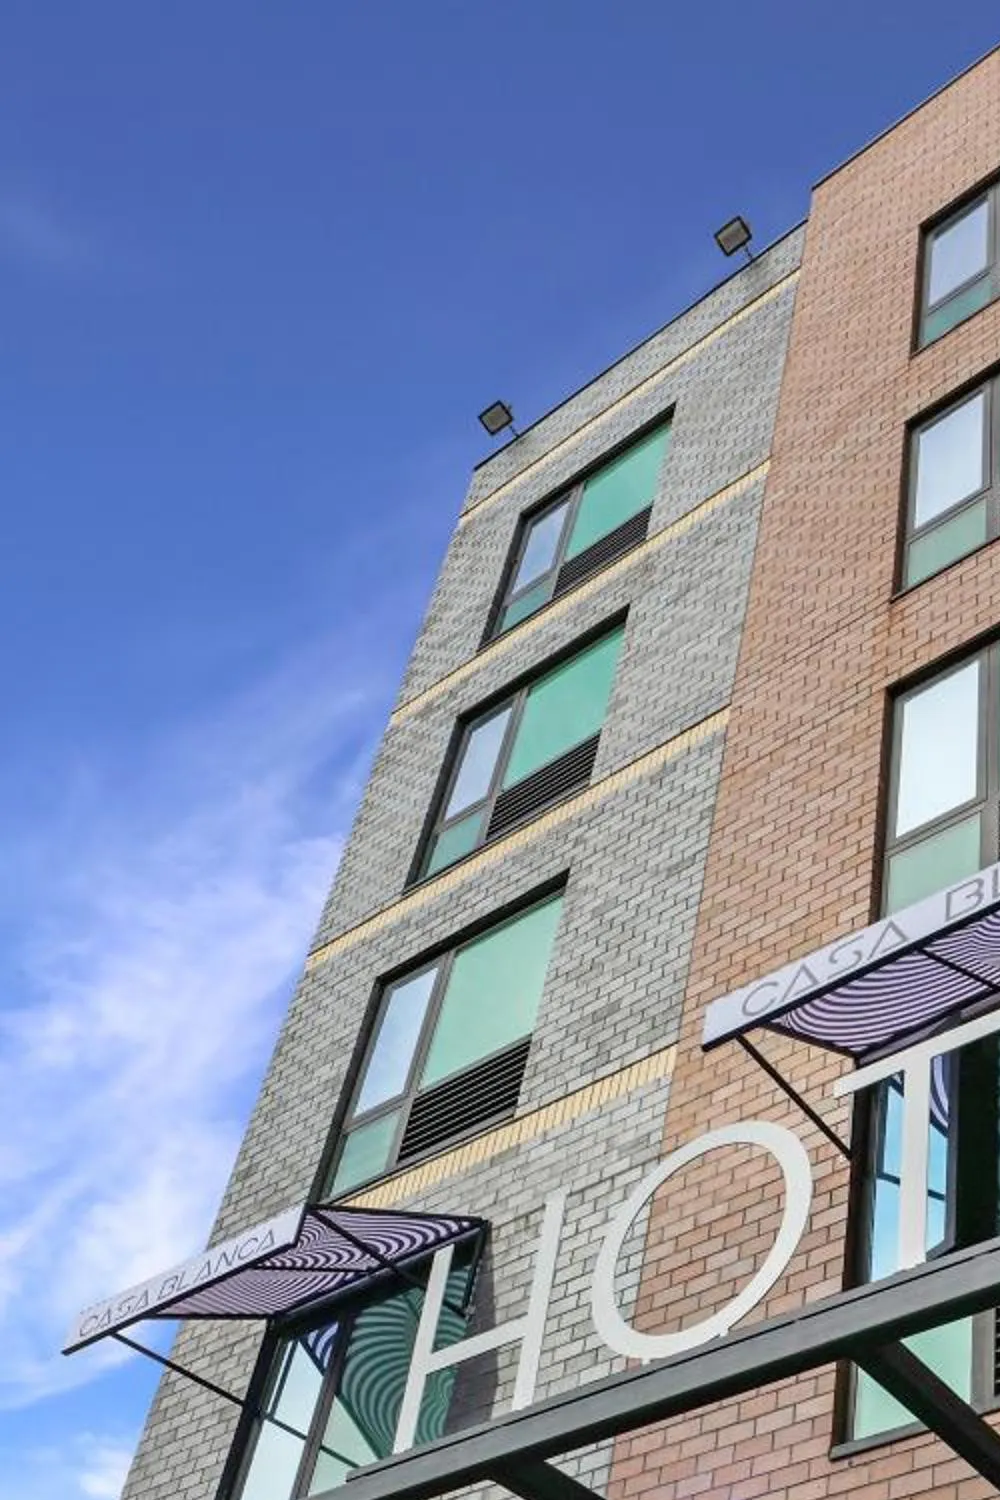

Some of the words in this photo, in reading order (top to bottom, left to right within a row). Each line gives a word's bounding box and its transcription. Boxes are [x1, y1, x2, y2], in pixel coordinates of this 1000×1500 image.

[741, 919, 911, 1017] CASA
[79, 1290, 150, 1338] CASA
[156, 1229, 276, 1302] BLANCA
